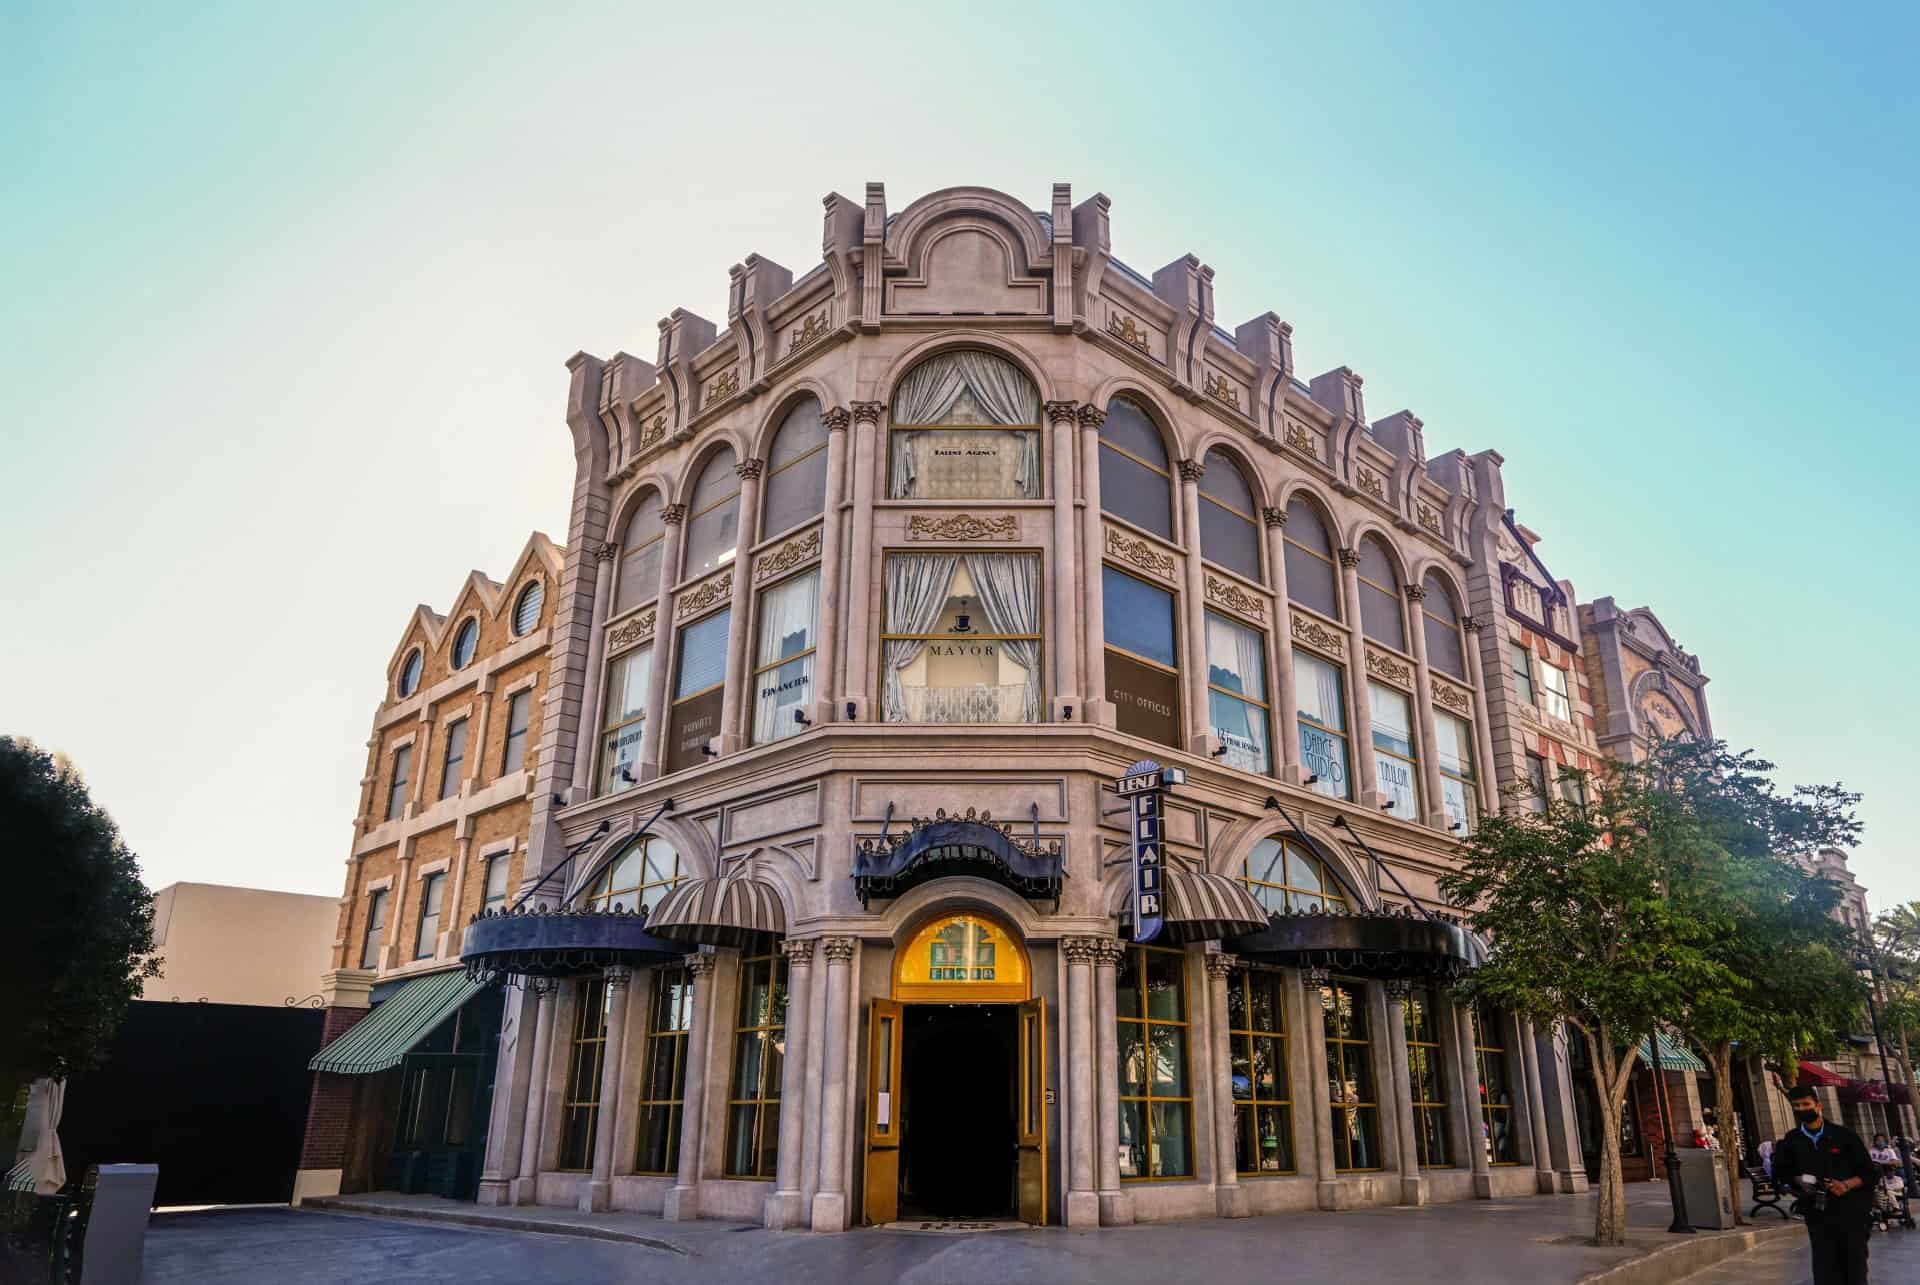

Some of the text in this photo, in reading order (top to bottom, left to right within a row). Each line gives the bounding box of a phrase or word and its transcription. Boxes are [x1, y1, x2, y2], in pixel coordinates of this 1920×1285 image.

[928, 645, 994, 657] MAYOR
[762, 675, 808, 699] FINANCIER
[1113, 689, 1171, 717] CITY OFFICES
[1303, 730, 1334, 761] DANCE
[1305, 751, 1344, 782] STUDIO
[1379, 760, 1409, 788] TAILOR
[1118, 774, 1158, 793] LENS
[1138, 795, 1159, 915] FLAIR
